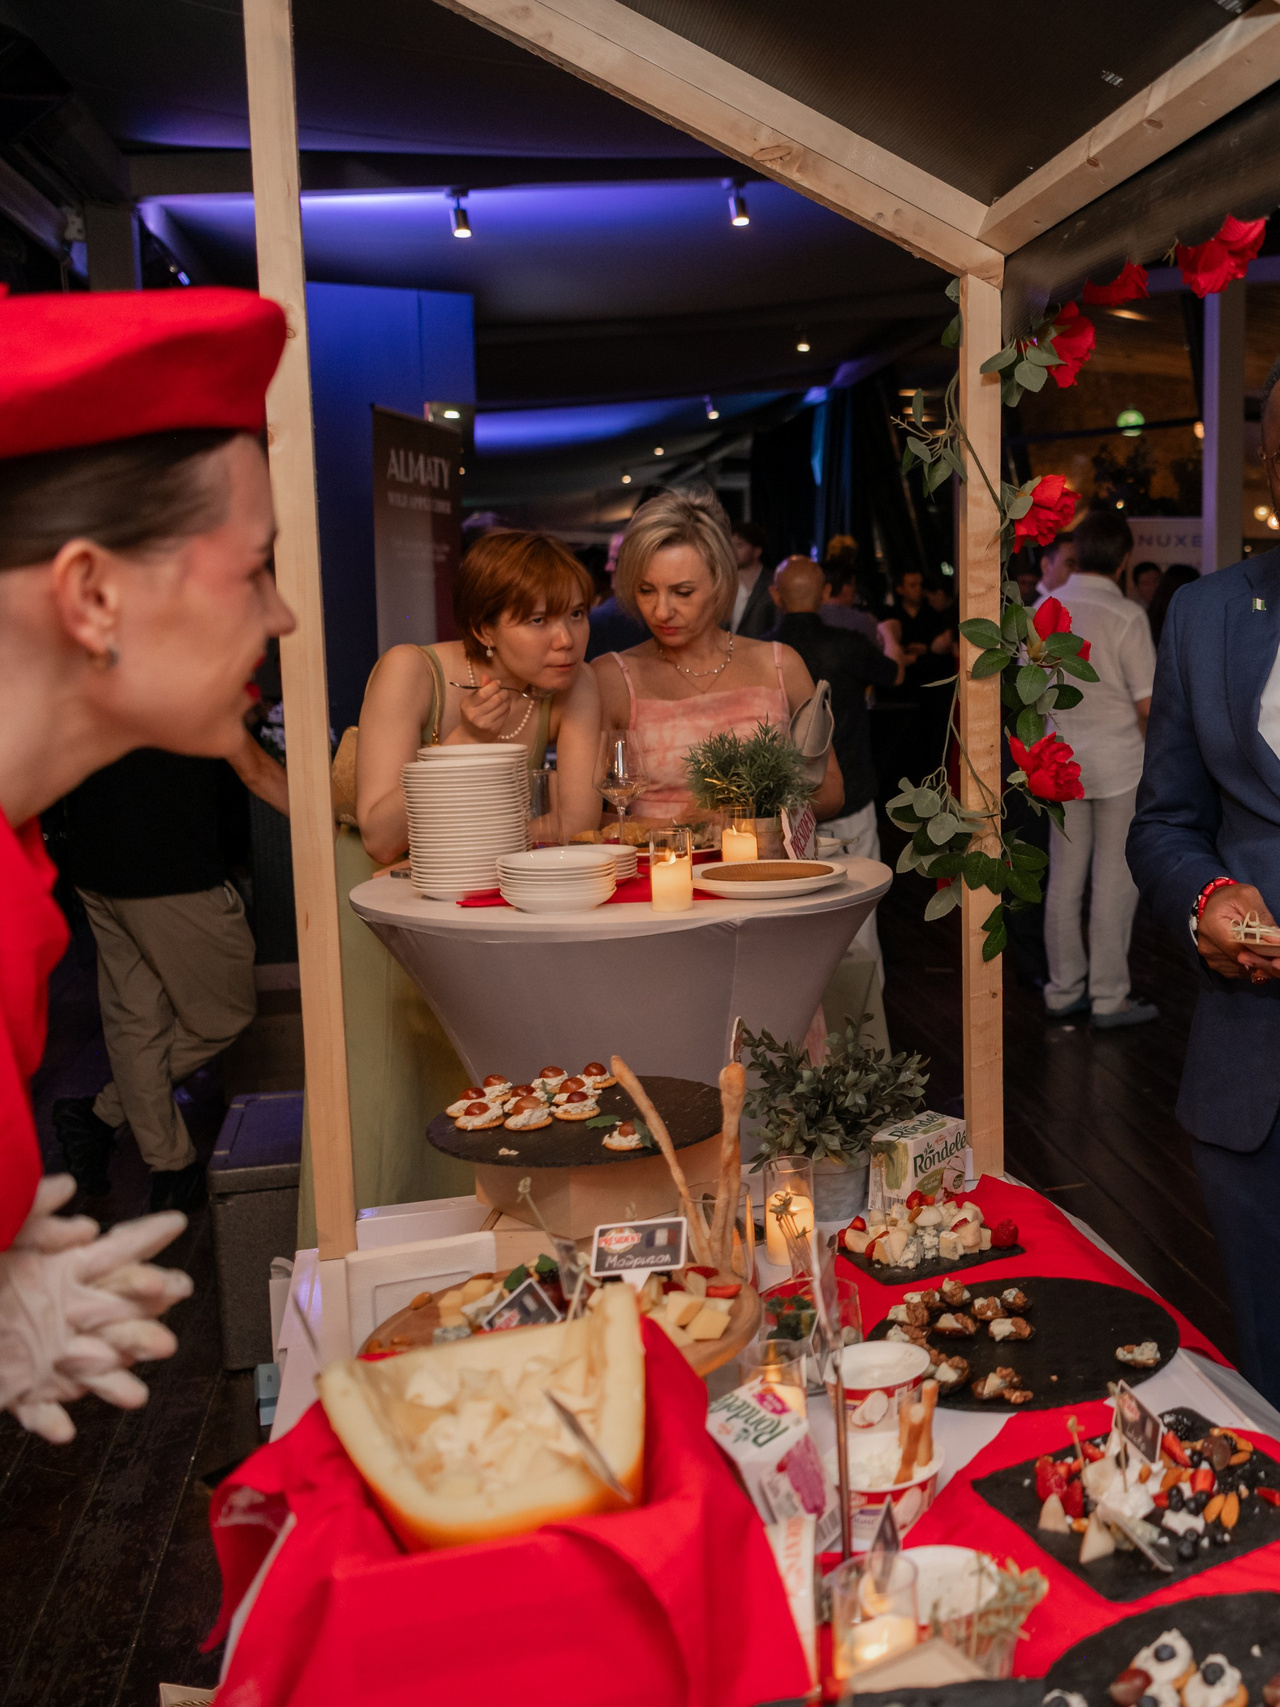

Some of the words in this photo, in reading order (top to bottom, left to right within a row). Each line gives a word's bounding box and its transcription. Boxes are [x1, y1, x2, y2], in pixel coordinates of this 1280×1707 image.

[386, 448, 451, 490] ALMATY
[1138, 534, 1202, 548] NUXE
[913, 1130, 967, 1178] Rondelé
